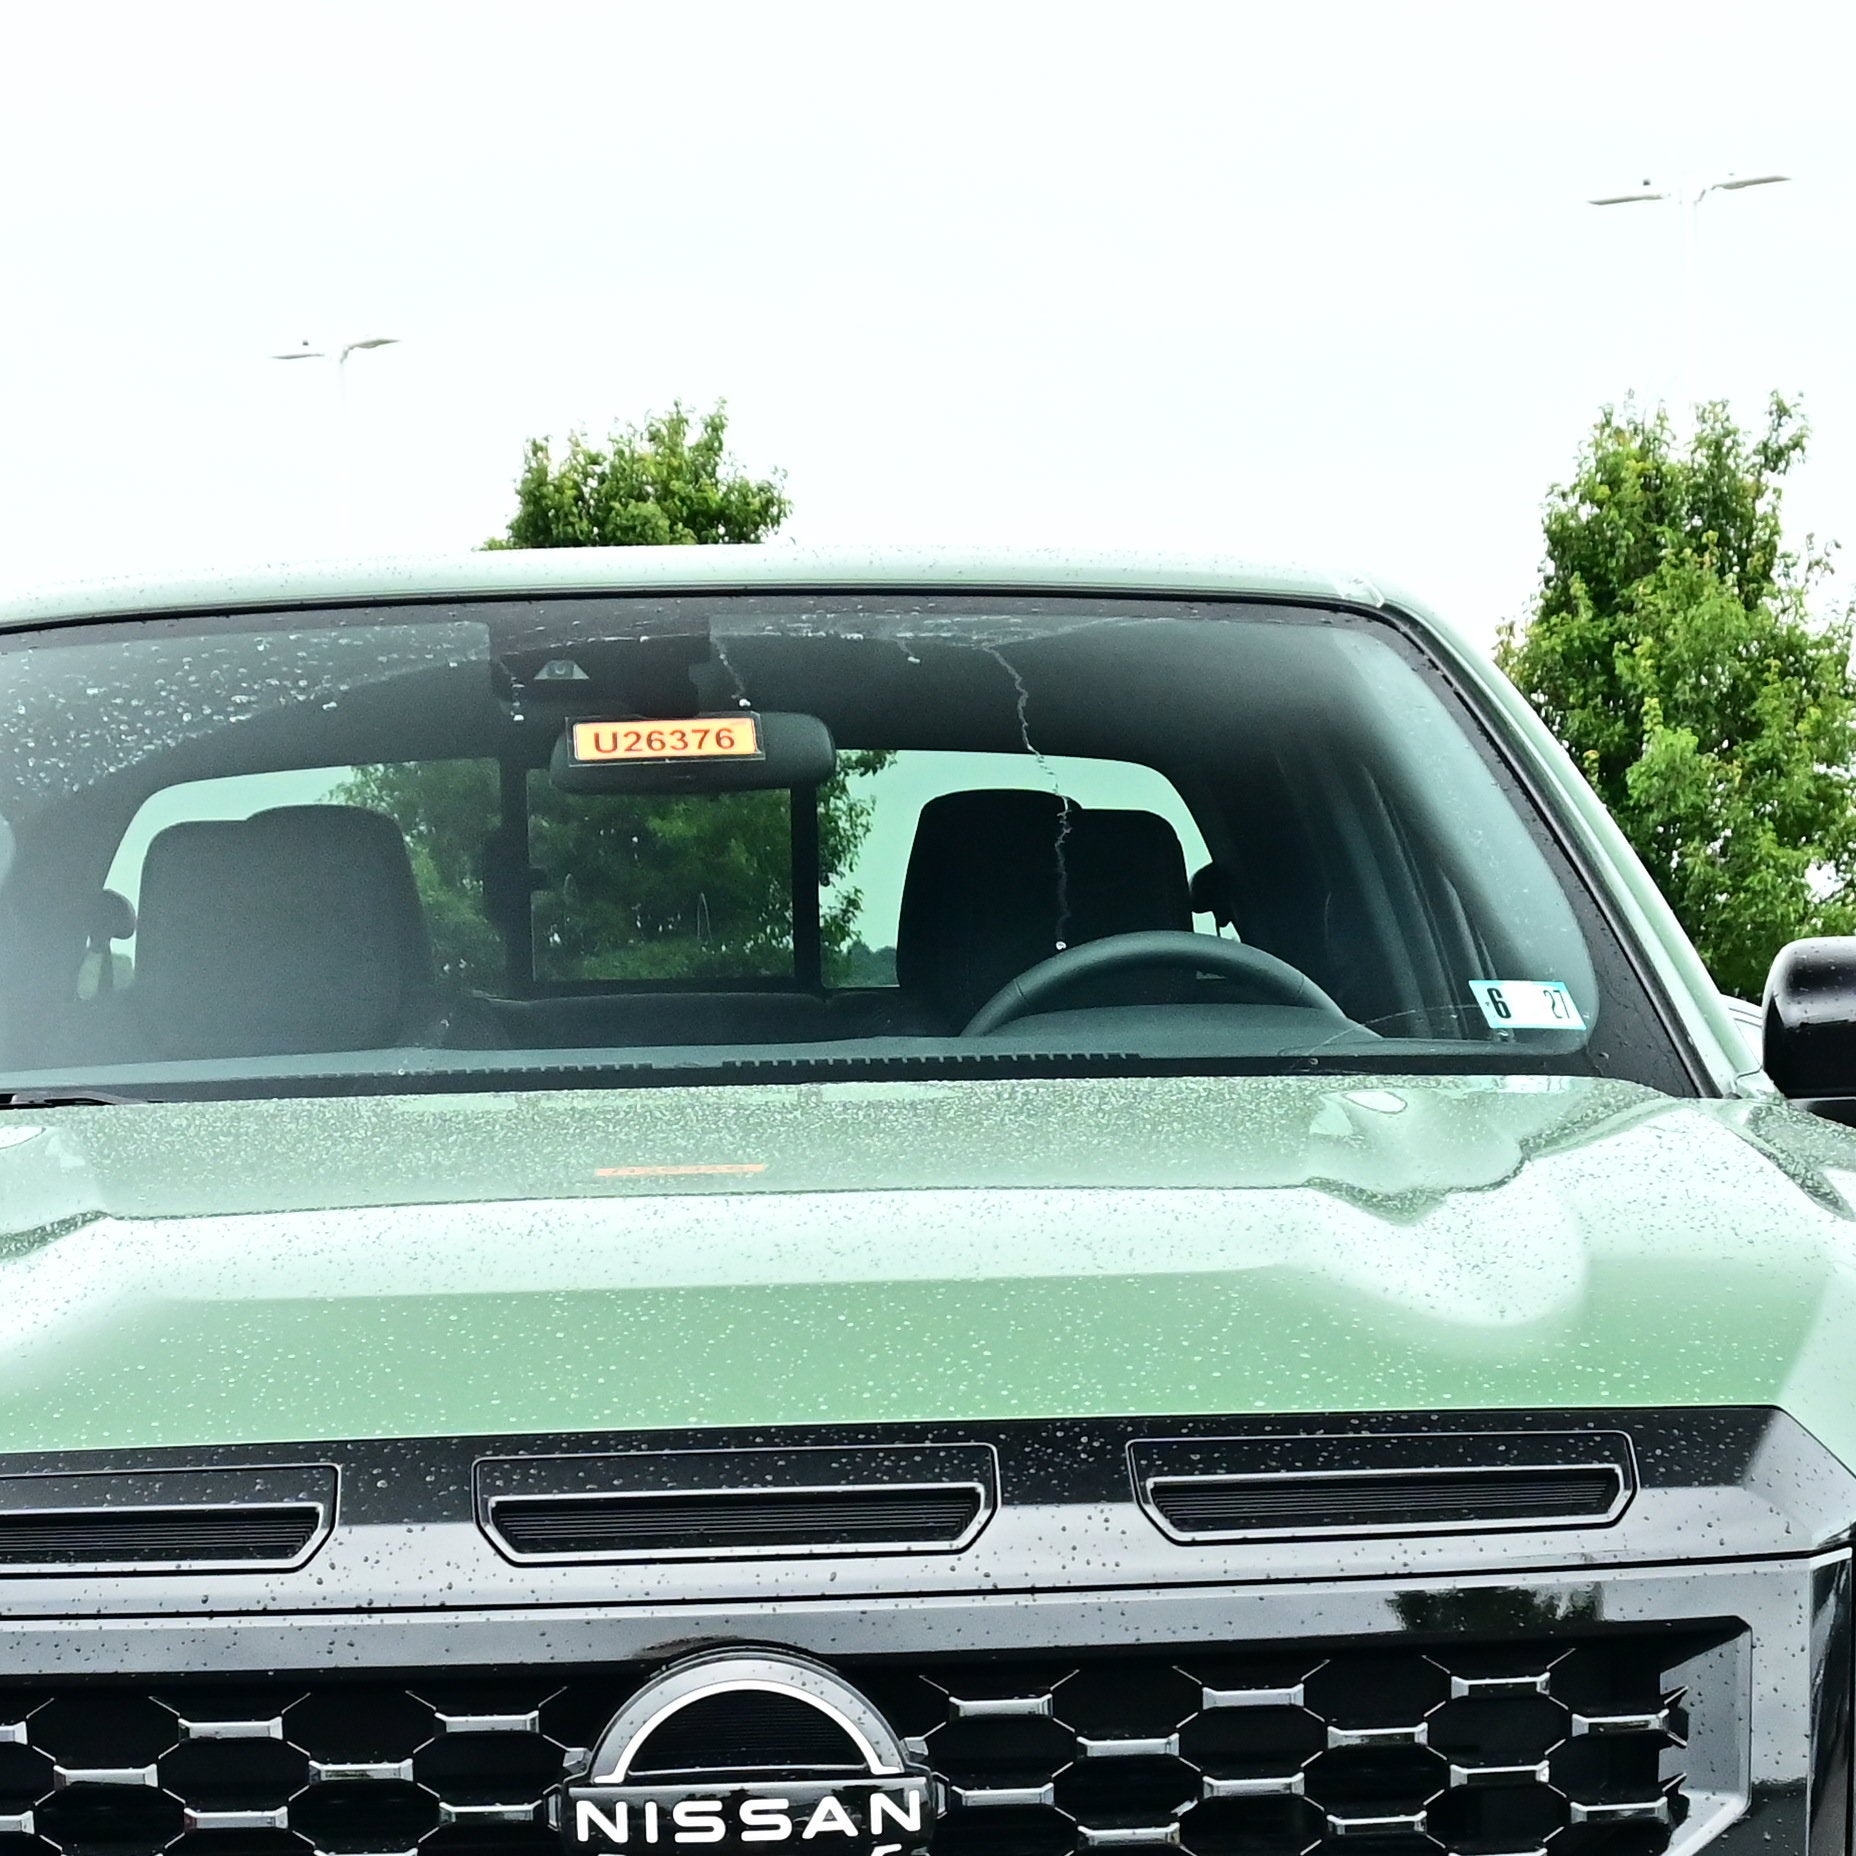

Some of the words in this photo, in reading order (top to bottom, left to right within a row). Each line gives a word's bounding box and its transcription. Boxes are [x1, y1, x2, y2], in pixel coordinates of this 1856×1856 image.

[593, 727, 736, 754] U26376
[1486, 987, 1512, 1019] 6
[1543, 989, 1571, 1019] 27
[575, 1789, 922, 1844] NISSAN
